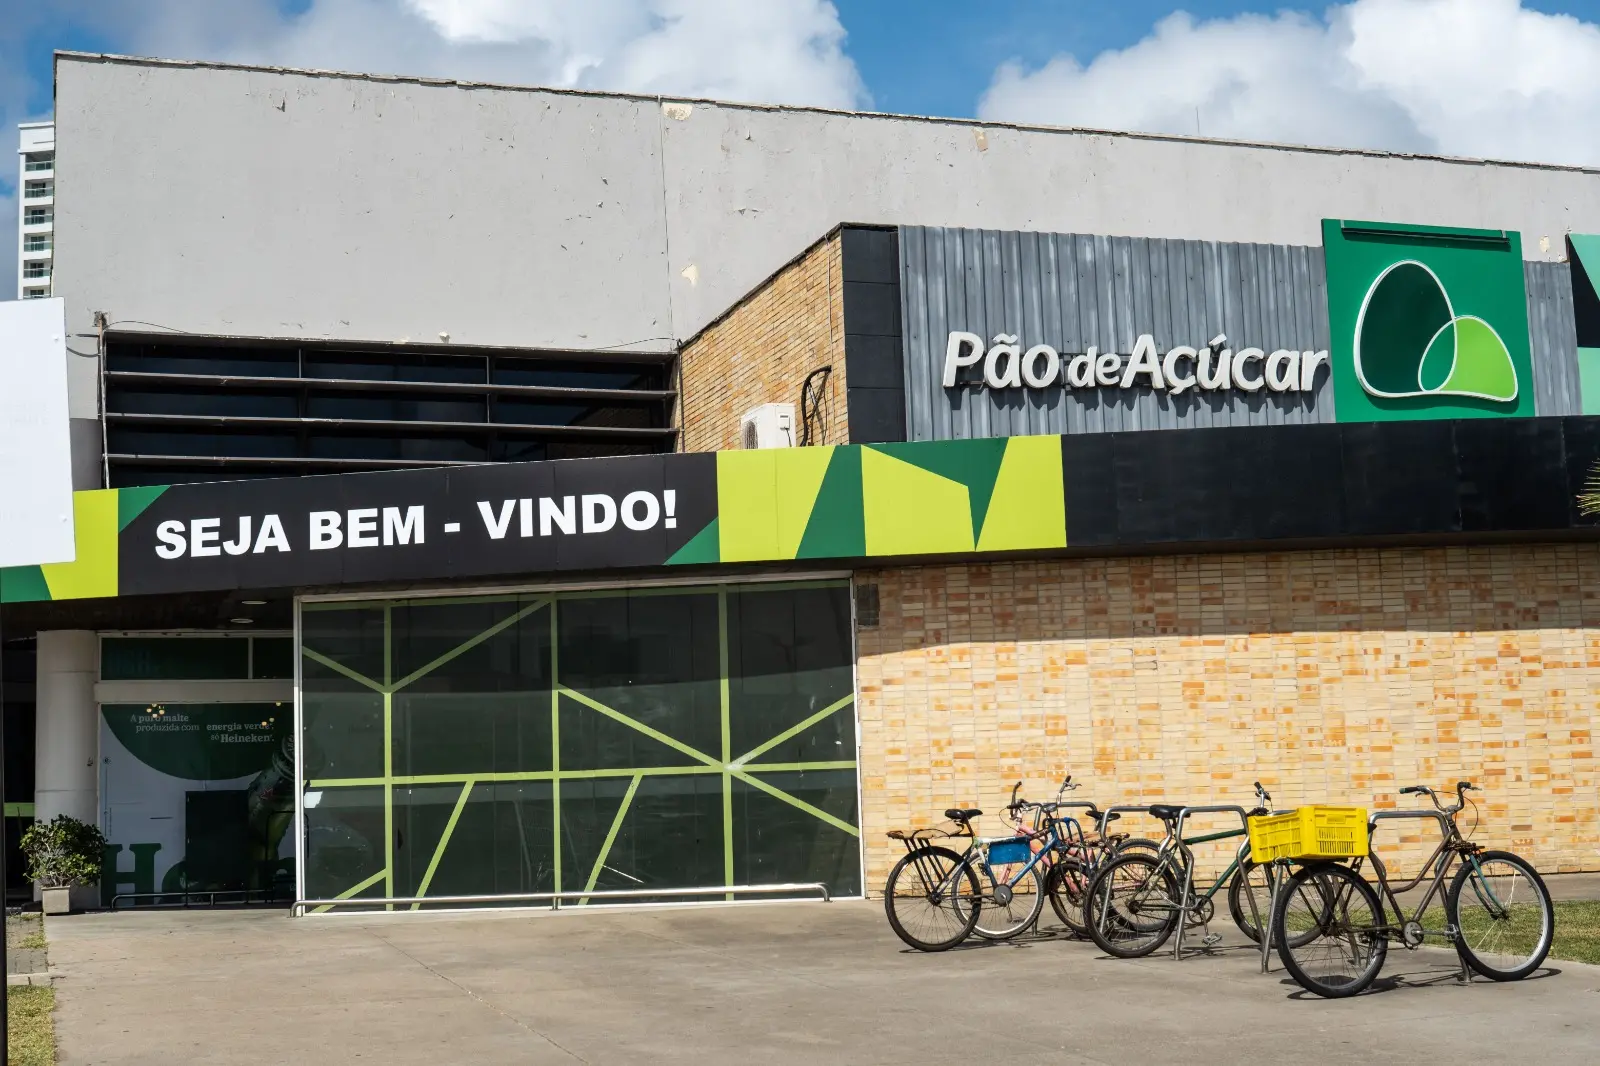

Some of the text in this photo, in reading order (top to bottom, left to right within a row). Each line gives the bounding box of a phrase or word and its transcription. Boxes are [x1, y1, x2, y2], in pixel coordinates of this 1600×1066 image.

[942, 331, 1059, 389] Pão
[155, 514, 290, 559] SEJA
[309, 505, 425, 550] BEM
[477, 490, 677, 539] VINDO!
[163, 714, 189, 722] malte
[136, 723, 180, 734] produzida
[206, 723, 242, 732] energia
